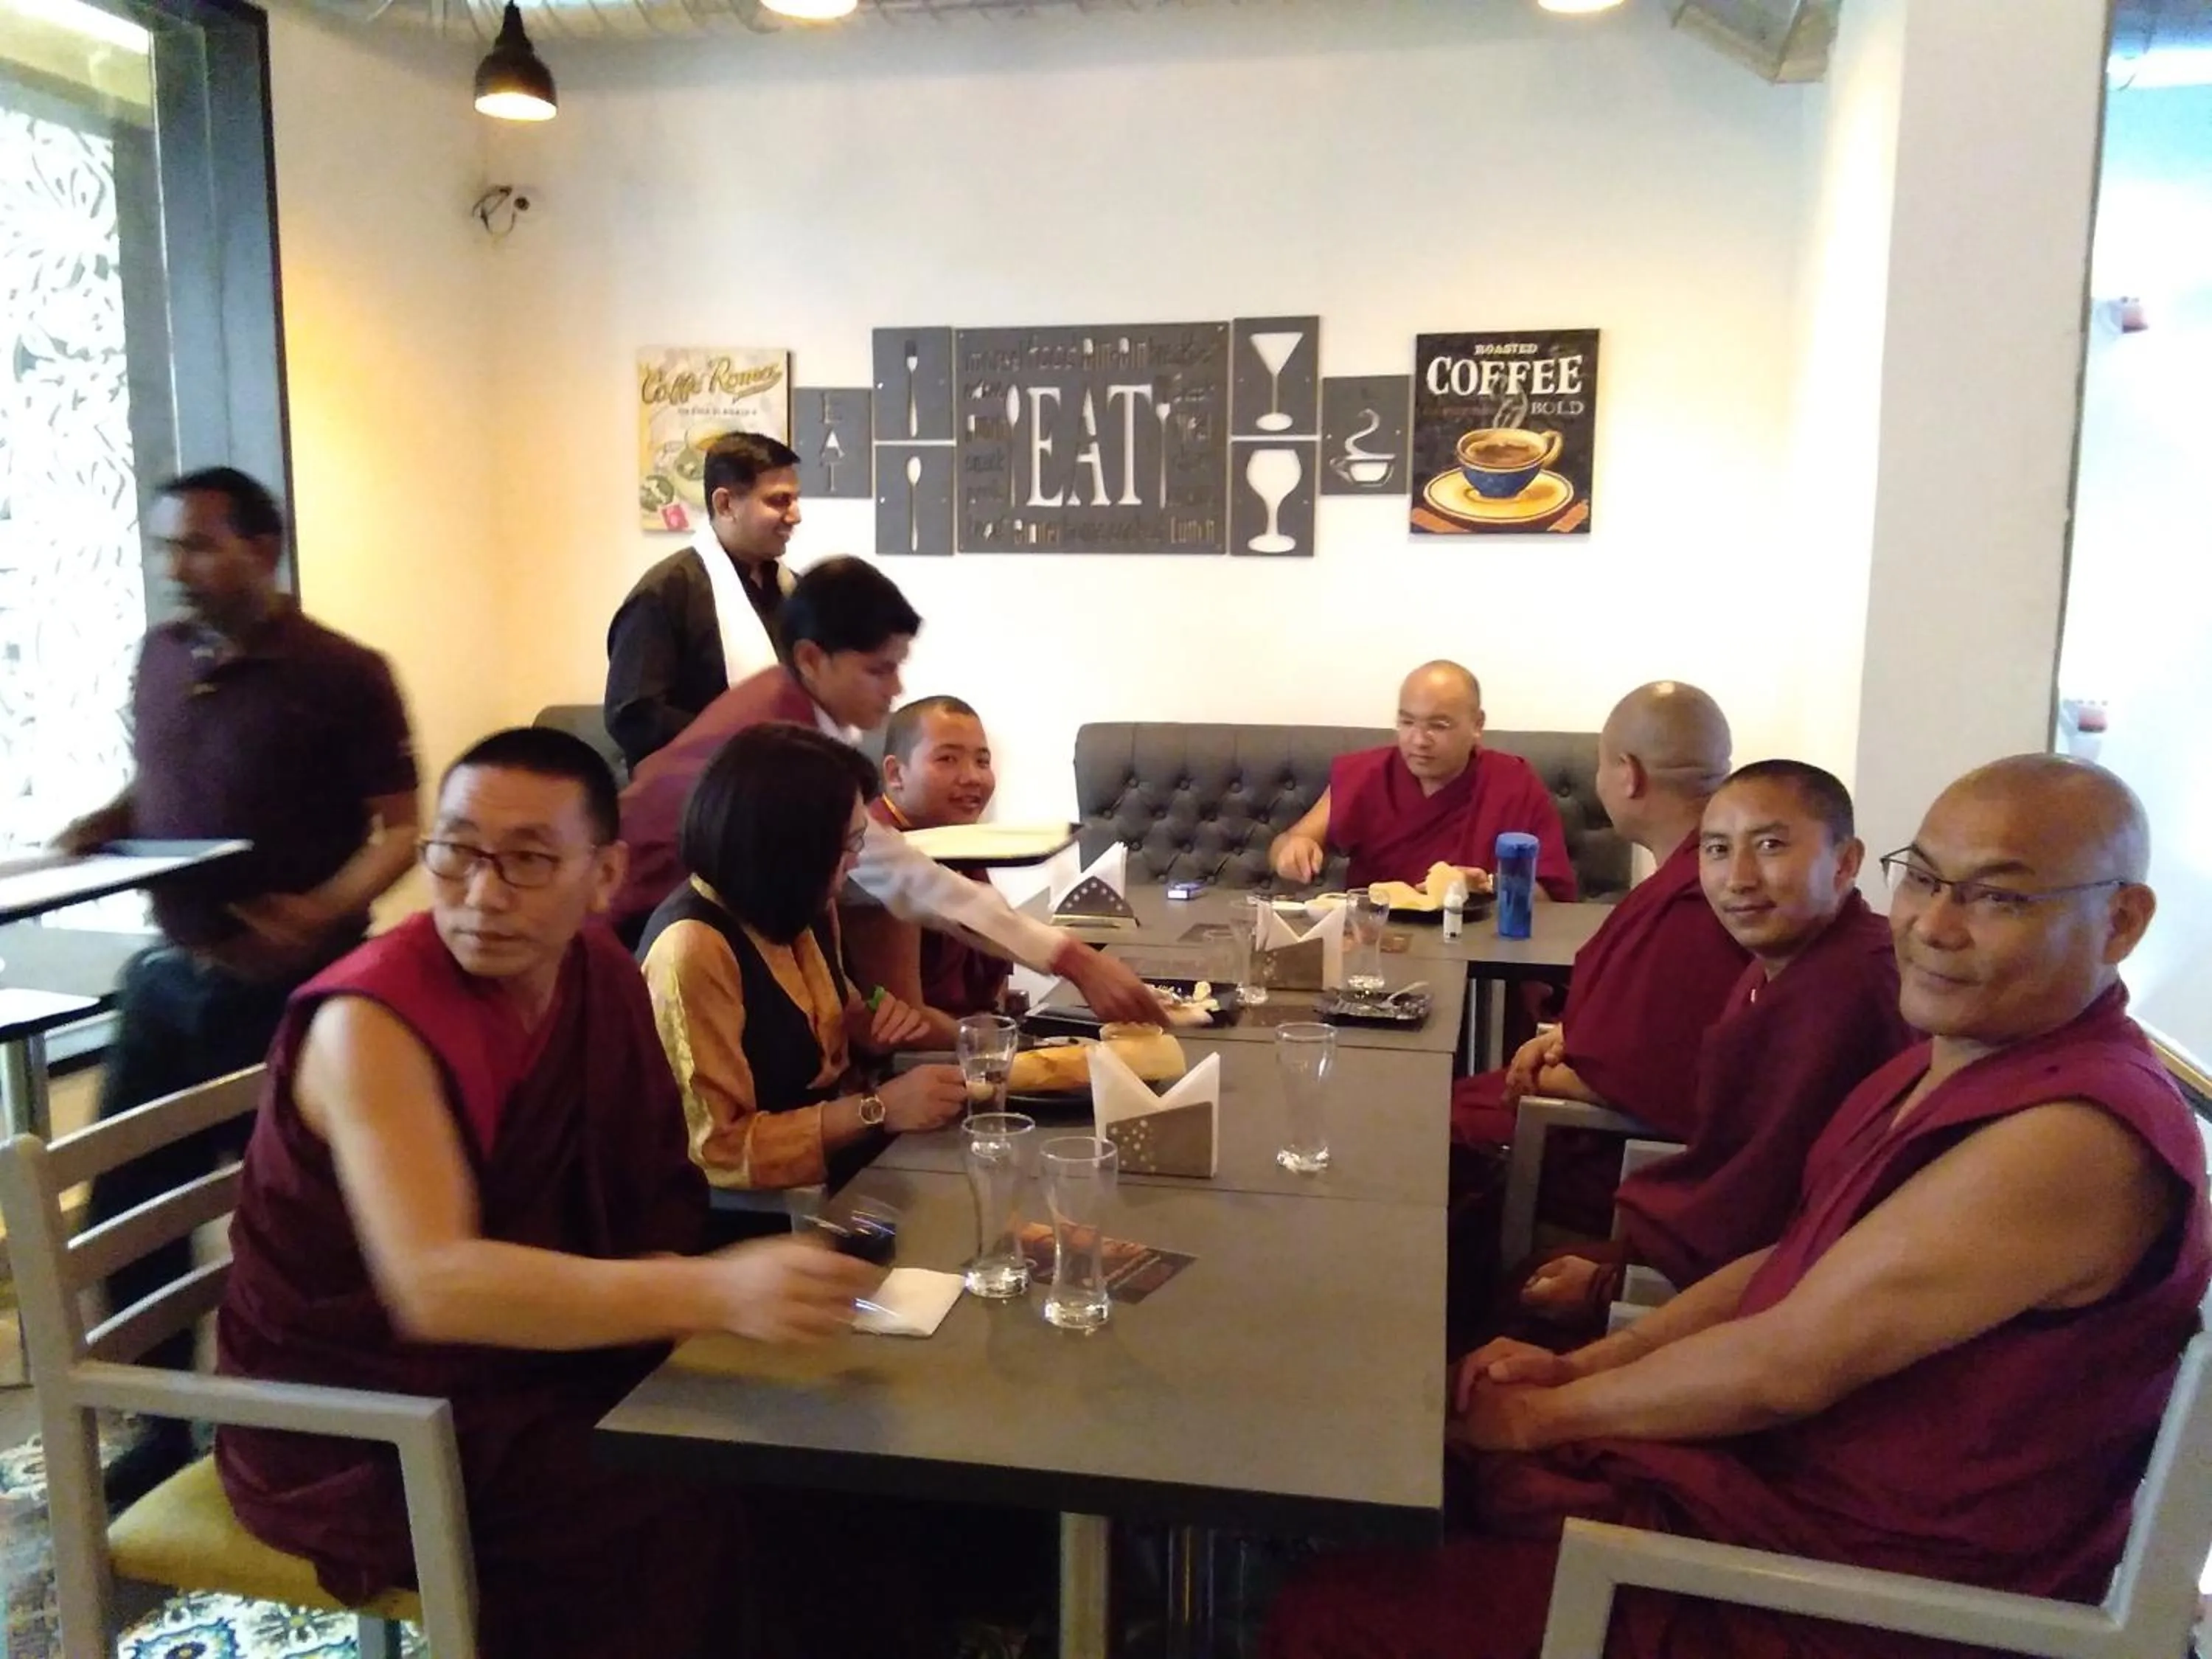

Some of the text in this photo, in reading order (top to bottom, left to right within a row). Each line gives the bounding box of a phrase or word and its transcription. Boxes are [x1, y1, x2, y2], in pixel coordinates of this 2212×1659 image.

[1475, 343, 1538, 355] ROASTED
[1427, 355, 1583, 396] COFFEE
[1531, 400, 1585, 416] BOLD
[1026, 383, 1152, 507] EAT
